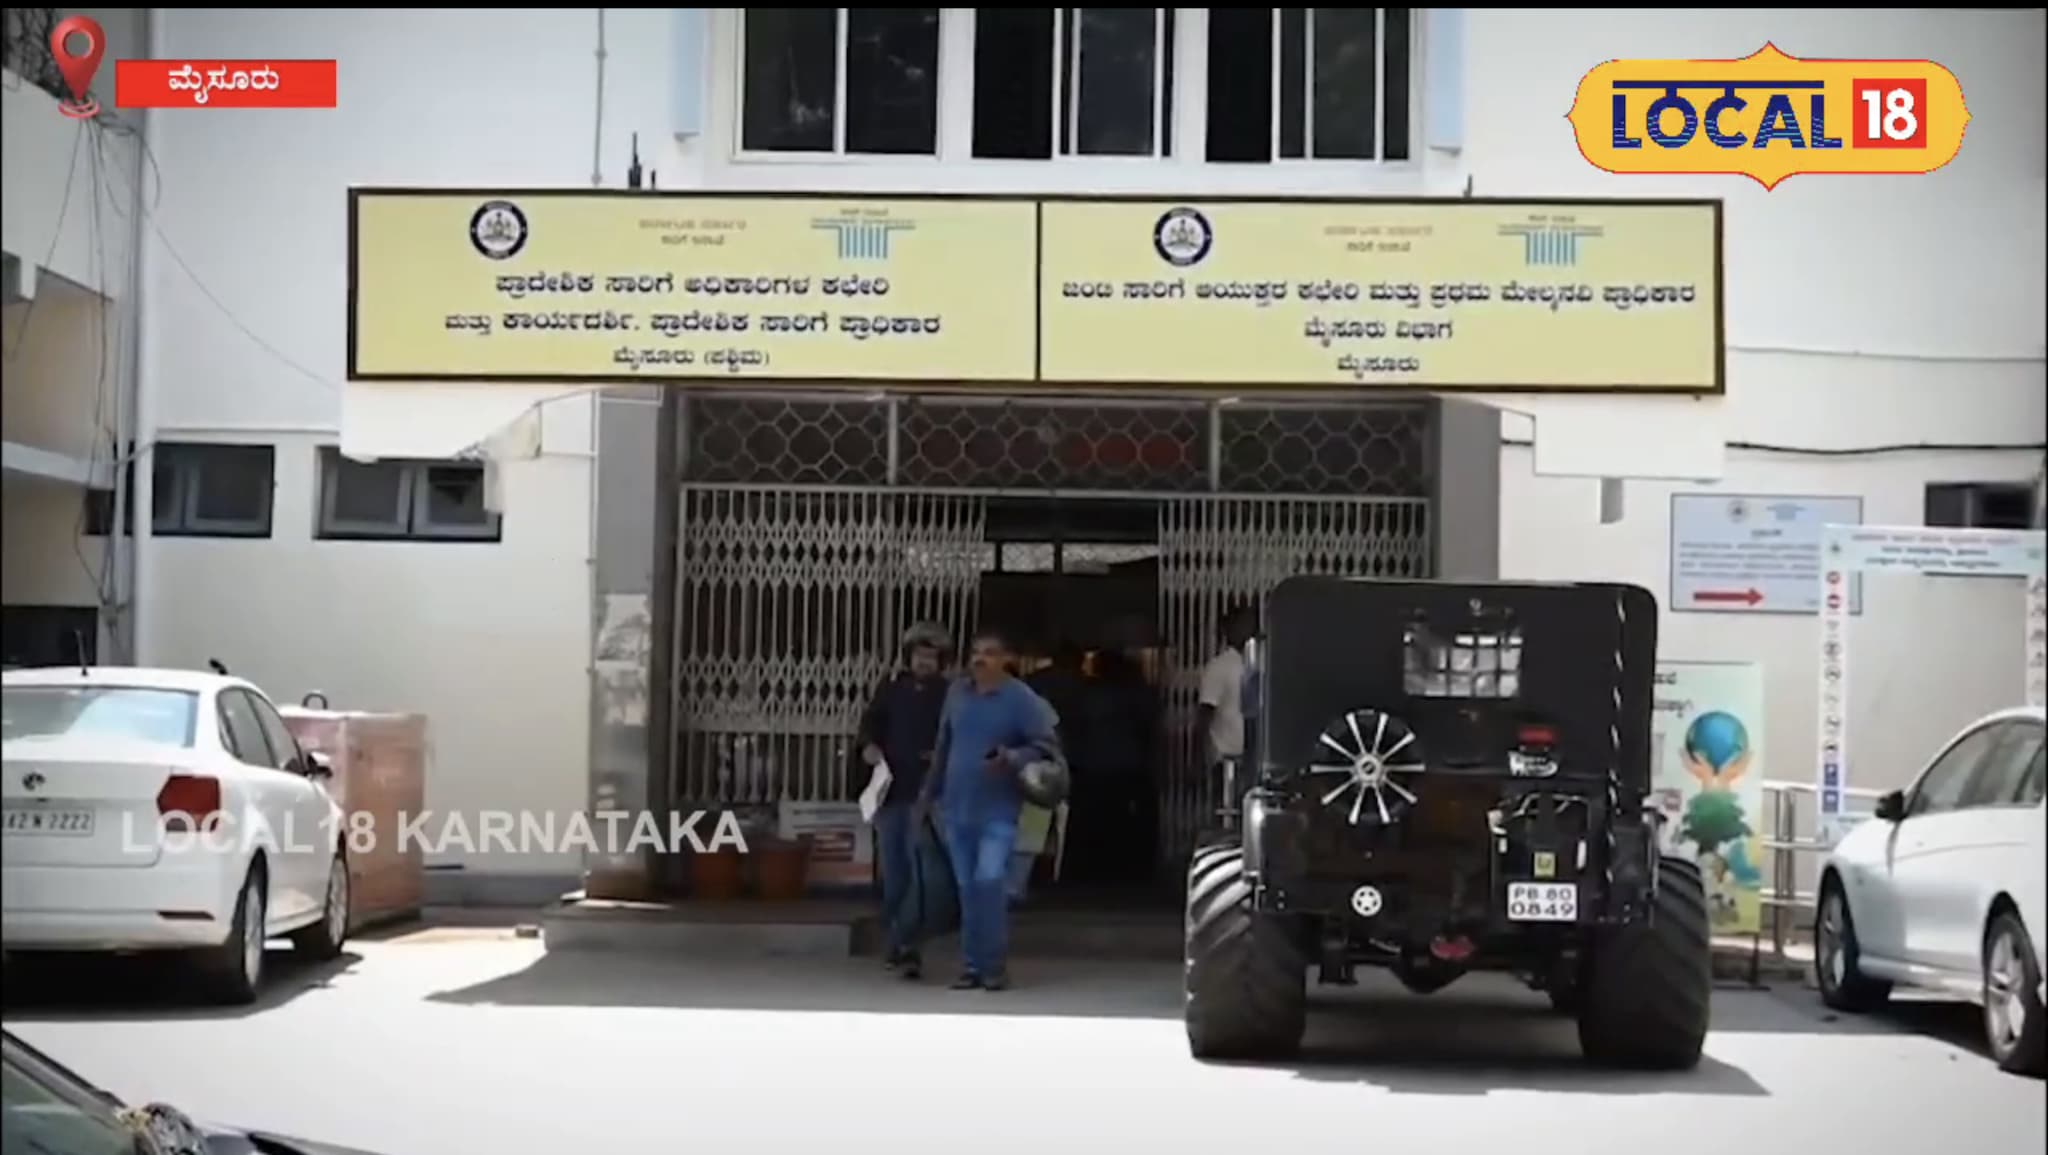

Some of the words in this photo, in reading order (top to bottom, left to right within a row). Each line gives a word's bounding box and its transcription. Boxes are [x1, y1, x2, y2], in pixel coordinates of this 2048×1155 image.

[495, 271, 595, 299] ಪ್ರಾದೇಶಿಕ
[605, 272, 675, 294] ಸಾರಿಗೆ
[684, 276, 811, 297] ಅಧಿಕಾರಿಗಳ
[1122, 278, 1186, 299] ಸಾರಿಗೆ
[1369, 283, 1421, 309] ಮತ್ತು
[1430, 284, 1491, 309] ಪ್ರಥಮ
[1602, 284, 1697, 310] ಪ್ರಾಧಿಕಾರ
[444, 314, 491, 336] ಮತ್ತು
[650, 310, 750, 339] ಪ್ರಾದೇಶಿಕ
[760, 311, 830, 333] ಸಾರಿಗೆ
[839, 314, 942, 341] ಪ್ರಾಧಿಕಾರ
[1304, 317, 1387, 348] ಮೈಸೂರು
[1395, 320, 1454, 342] ವಿಭಾಗ
[613, 346, 695, 371] ಮೈಸೂರು
[1337, 355, 1420, 379] ಮೈಸೂರು
[1511, 901, 1574, 916] 0849
